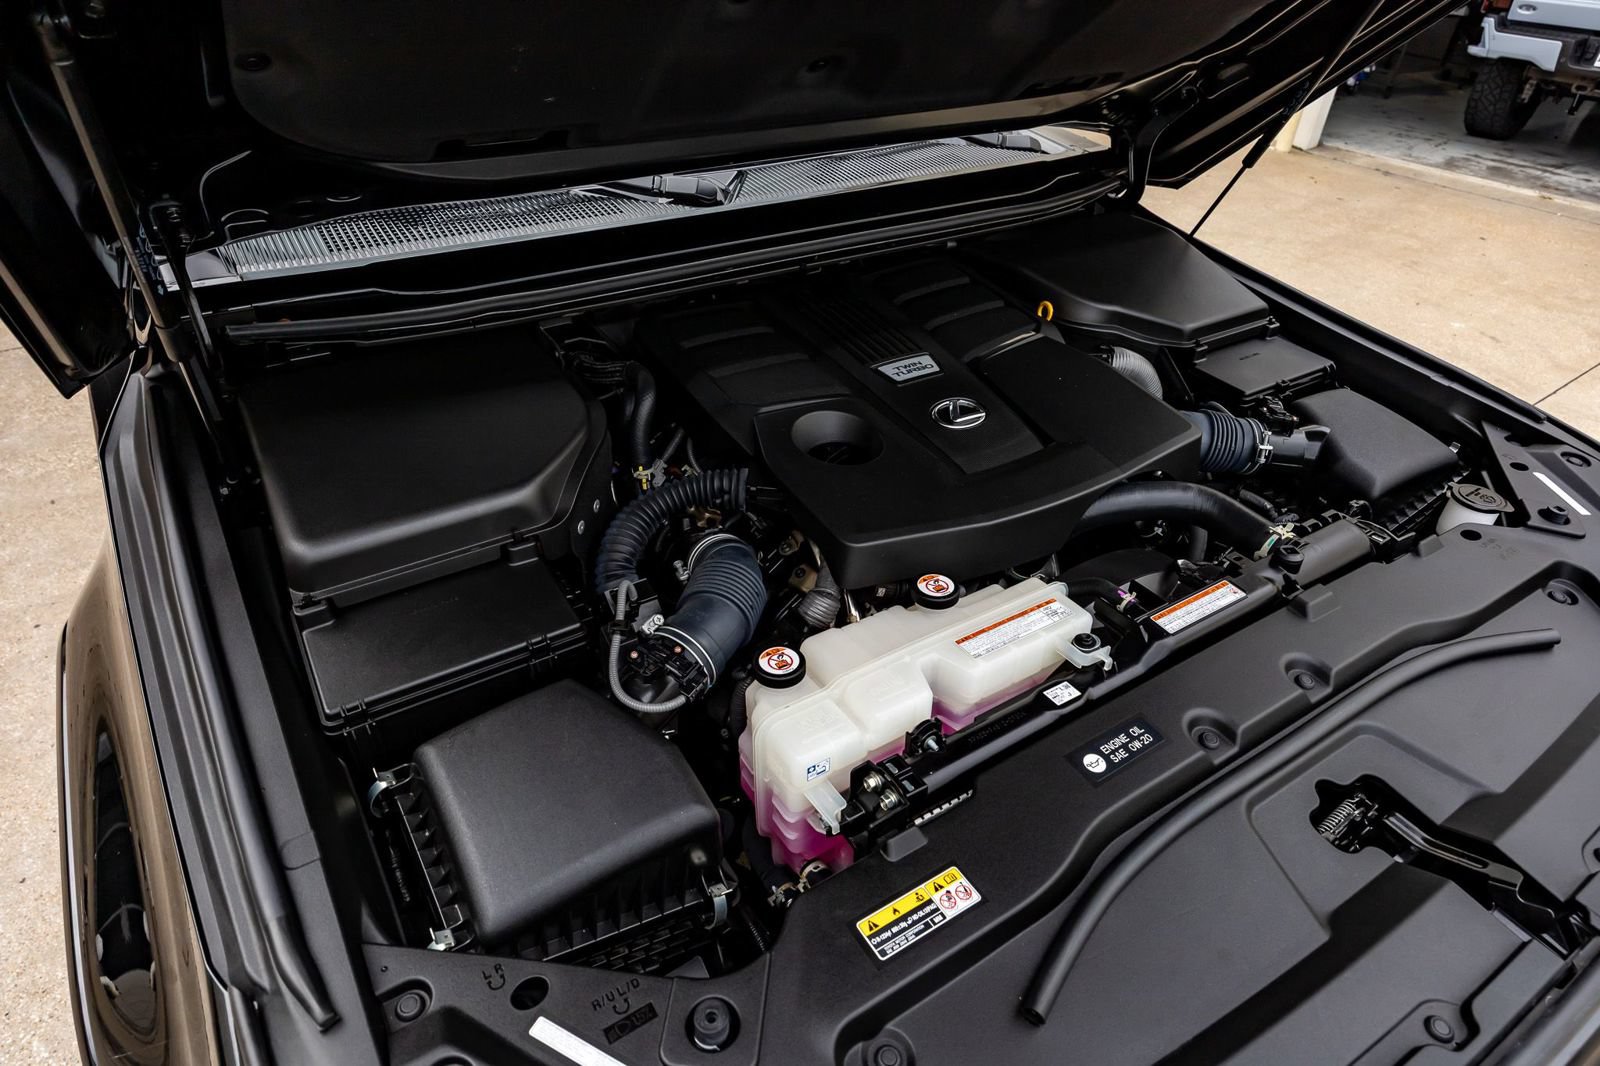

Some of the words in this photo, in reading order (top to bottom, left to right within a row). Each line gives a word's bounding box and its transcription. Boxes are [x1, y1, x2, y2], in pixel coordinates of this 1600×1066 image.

[891, 363, 934, 377] TURBO
[892, 360, 922, 372] TWIN
[1100, 733, 1130, 755] ENGINE
[1129, 725, 1145, 737] OIL
[1109, 748, 1129, 763] SAE
[1128, 733, 1154, 752] 0W-20
